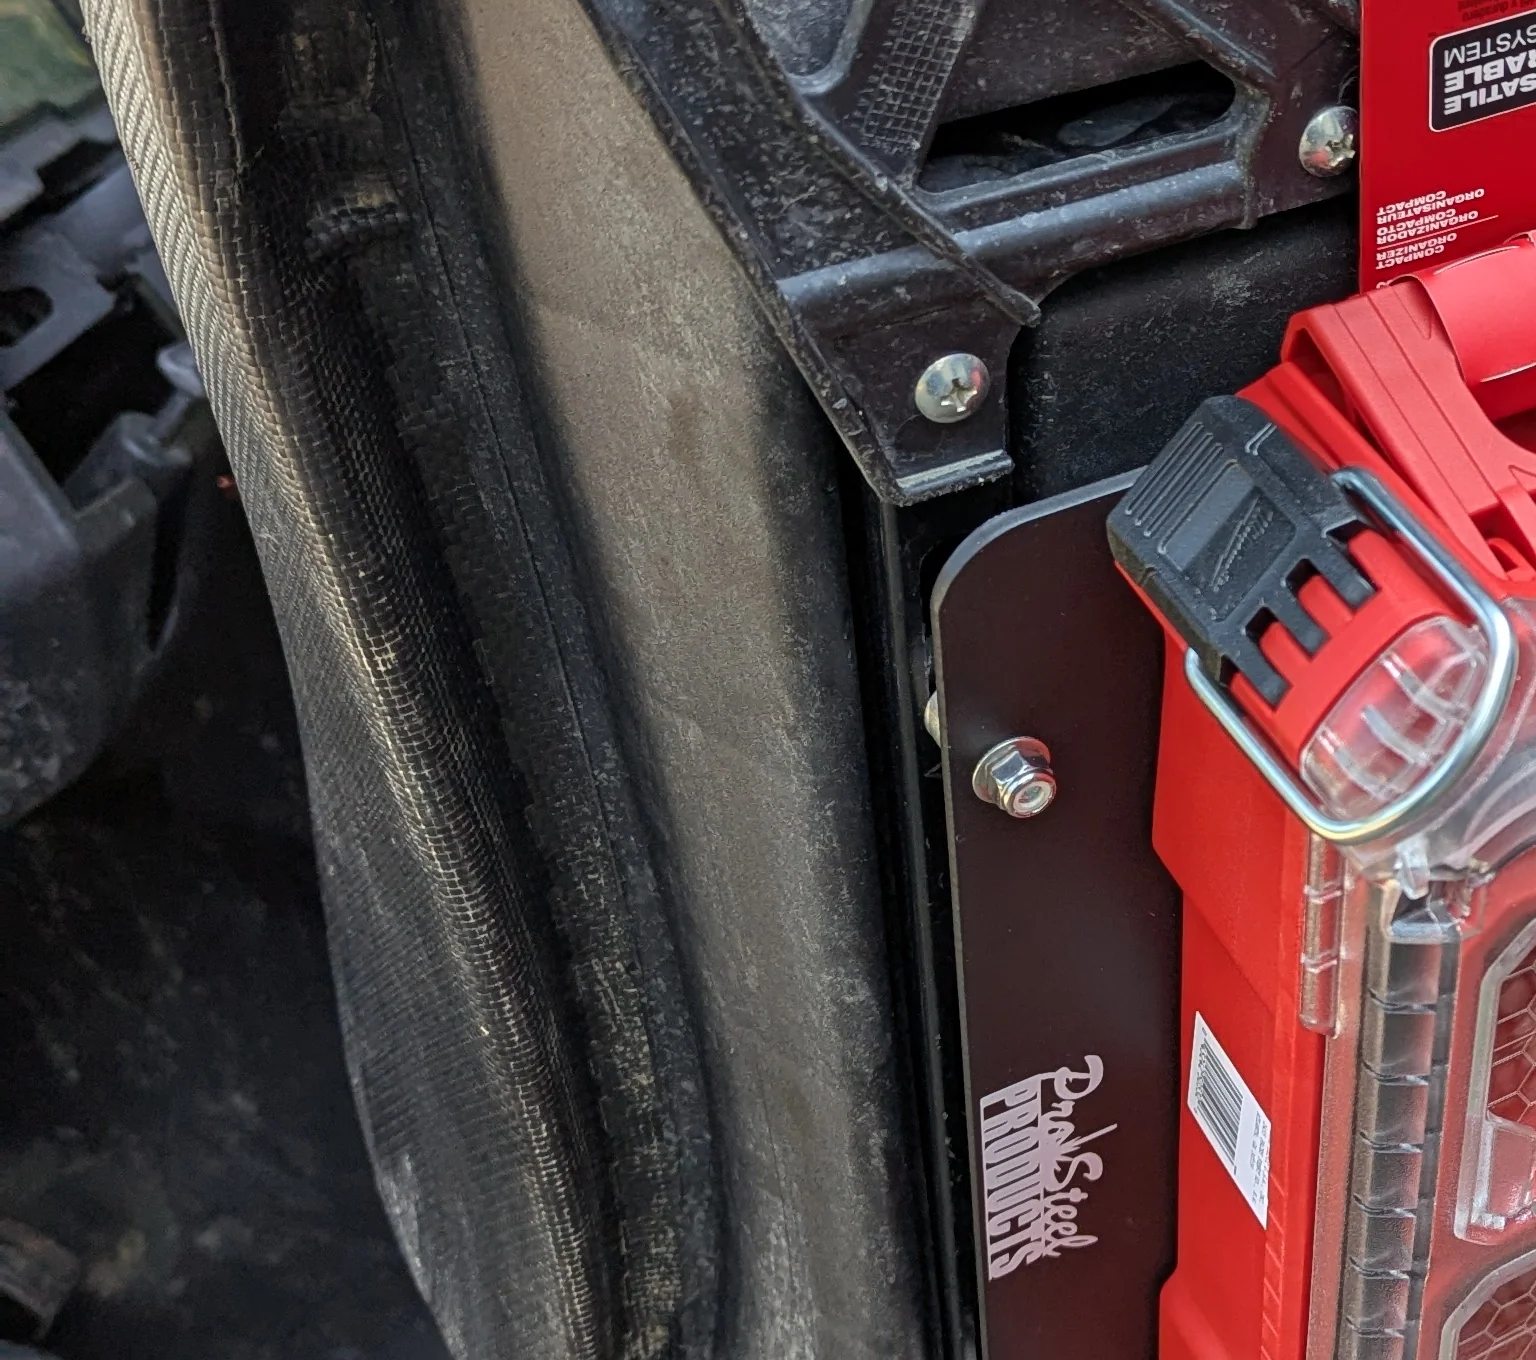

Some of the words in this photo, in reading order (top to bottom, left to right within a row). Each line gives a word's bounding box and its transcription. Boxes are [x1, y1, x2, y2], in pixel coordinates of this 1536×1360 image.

[1376, 190, 1446, 216] COMPACT
[1376, 188, 1484, 224] ORGANISATEUR
[1376, 208, 1456, 235] COMPACTO
[1376, 210, 1478, 244] ORGANIZADOR
[1376, 233, 1457, 260] ORGANIZER
[1376, 244, 1445, 270] COMPACT
[1041, 1055, 1104, 1145] Pro
[980, 1074, 1042, 1280] PRODUCTS
[1042, 1152, 1104, 1258] Steel
